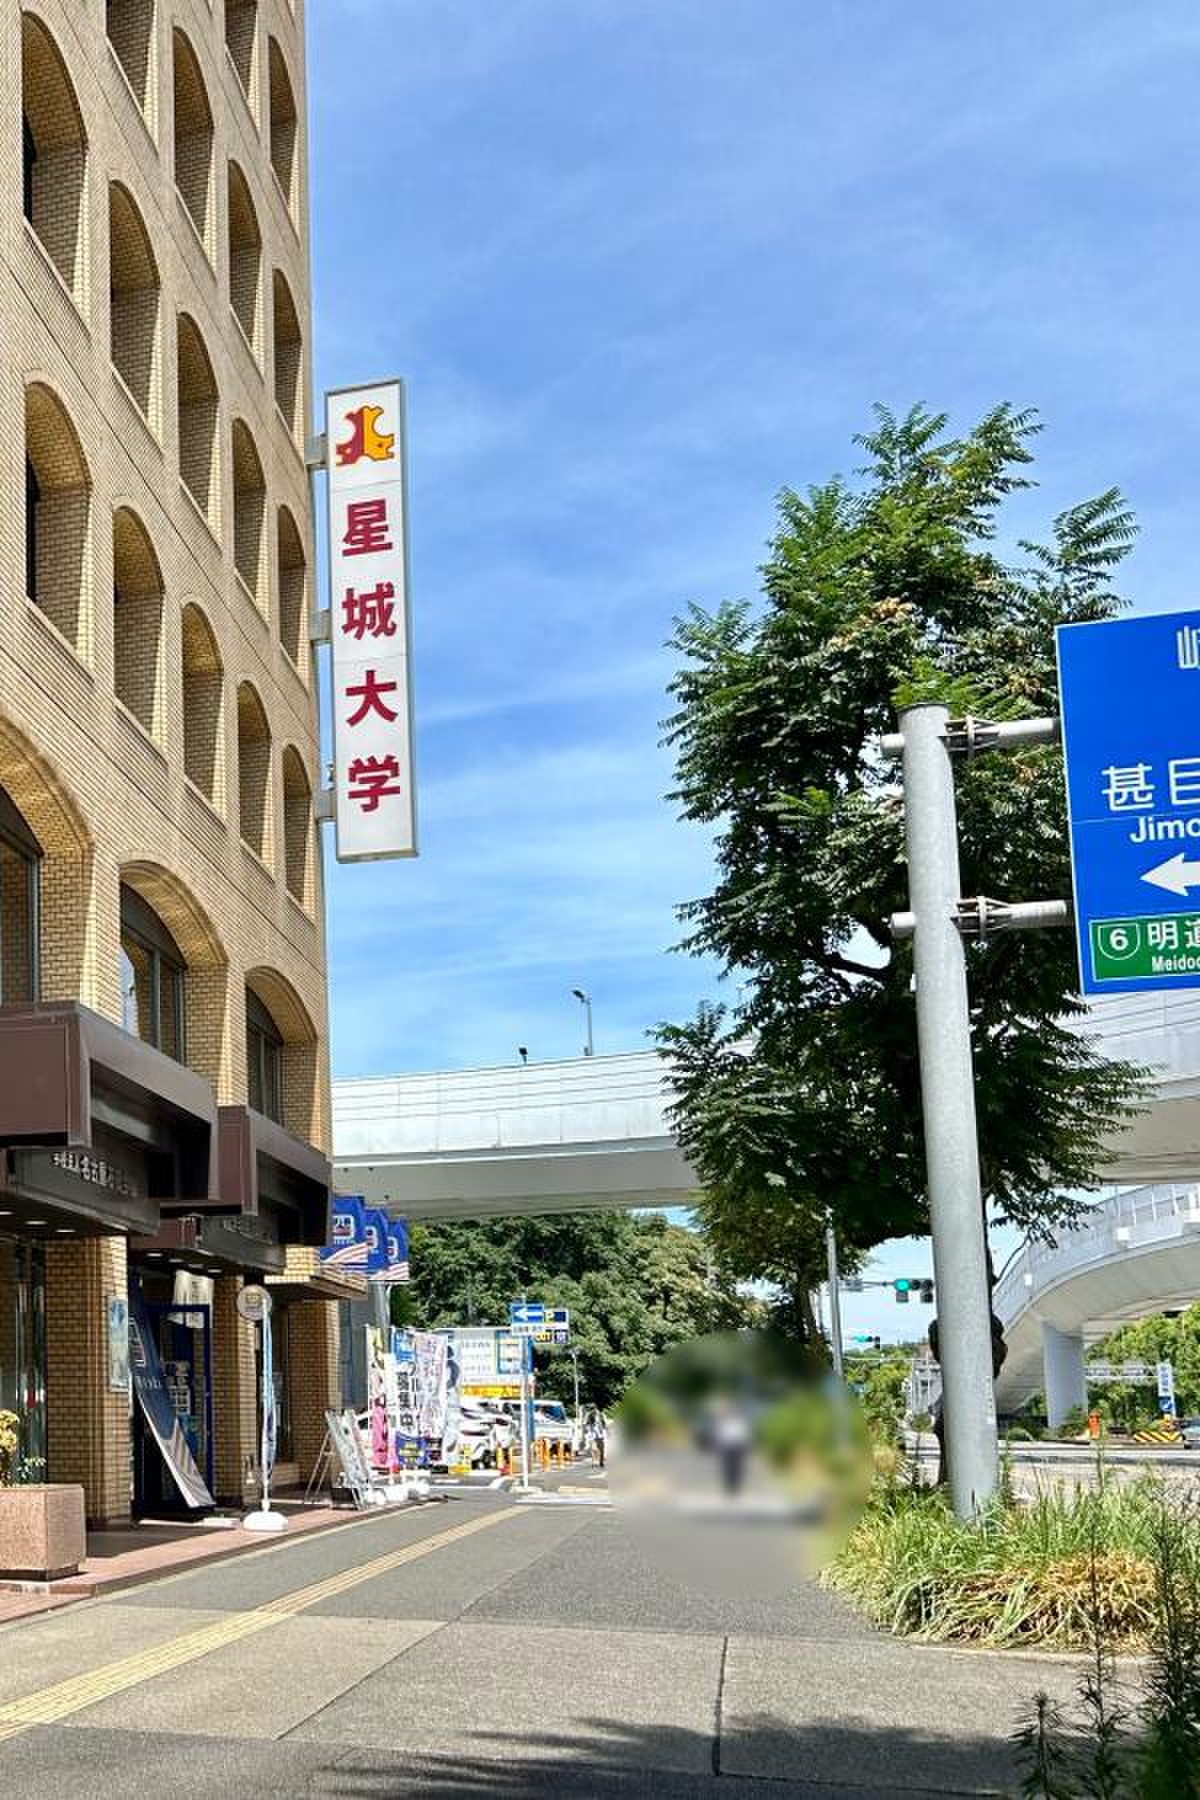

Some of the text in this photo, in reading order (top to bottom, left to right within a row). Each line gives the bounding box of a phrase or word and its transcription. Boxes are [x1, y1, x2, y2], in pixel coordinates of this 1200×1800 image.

[341, 498, 401, 813] 星城大学
[1109, 927, 1128, 951] 6
